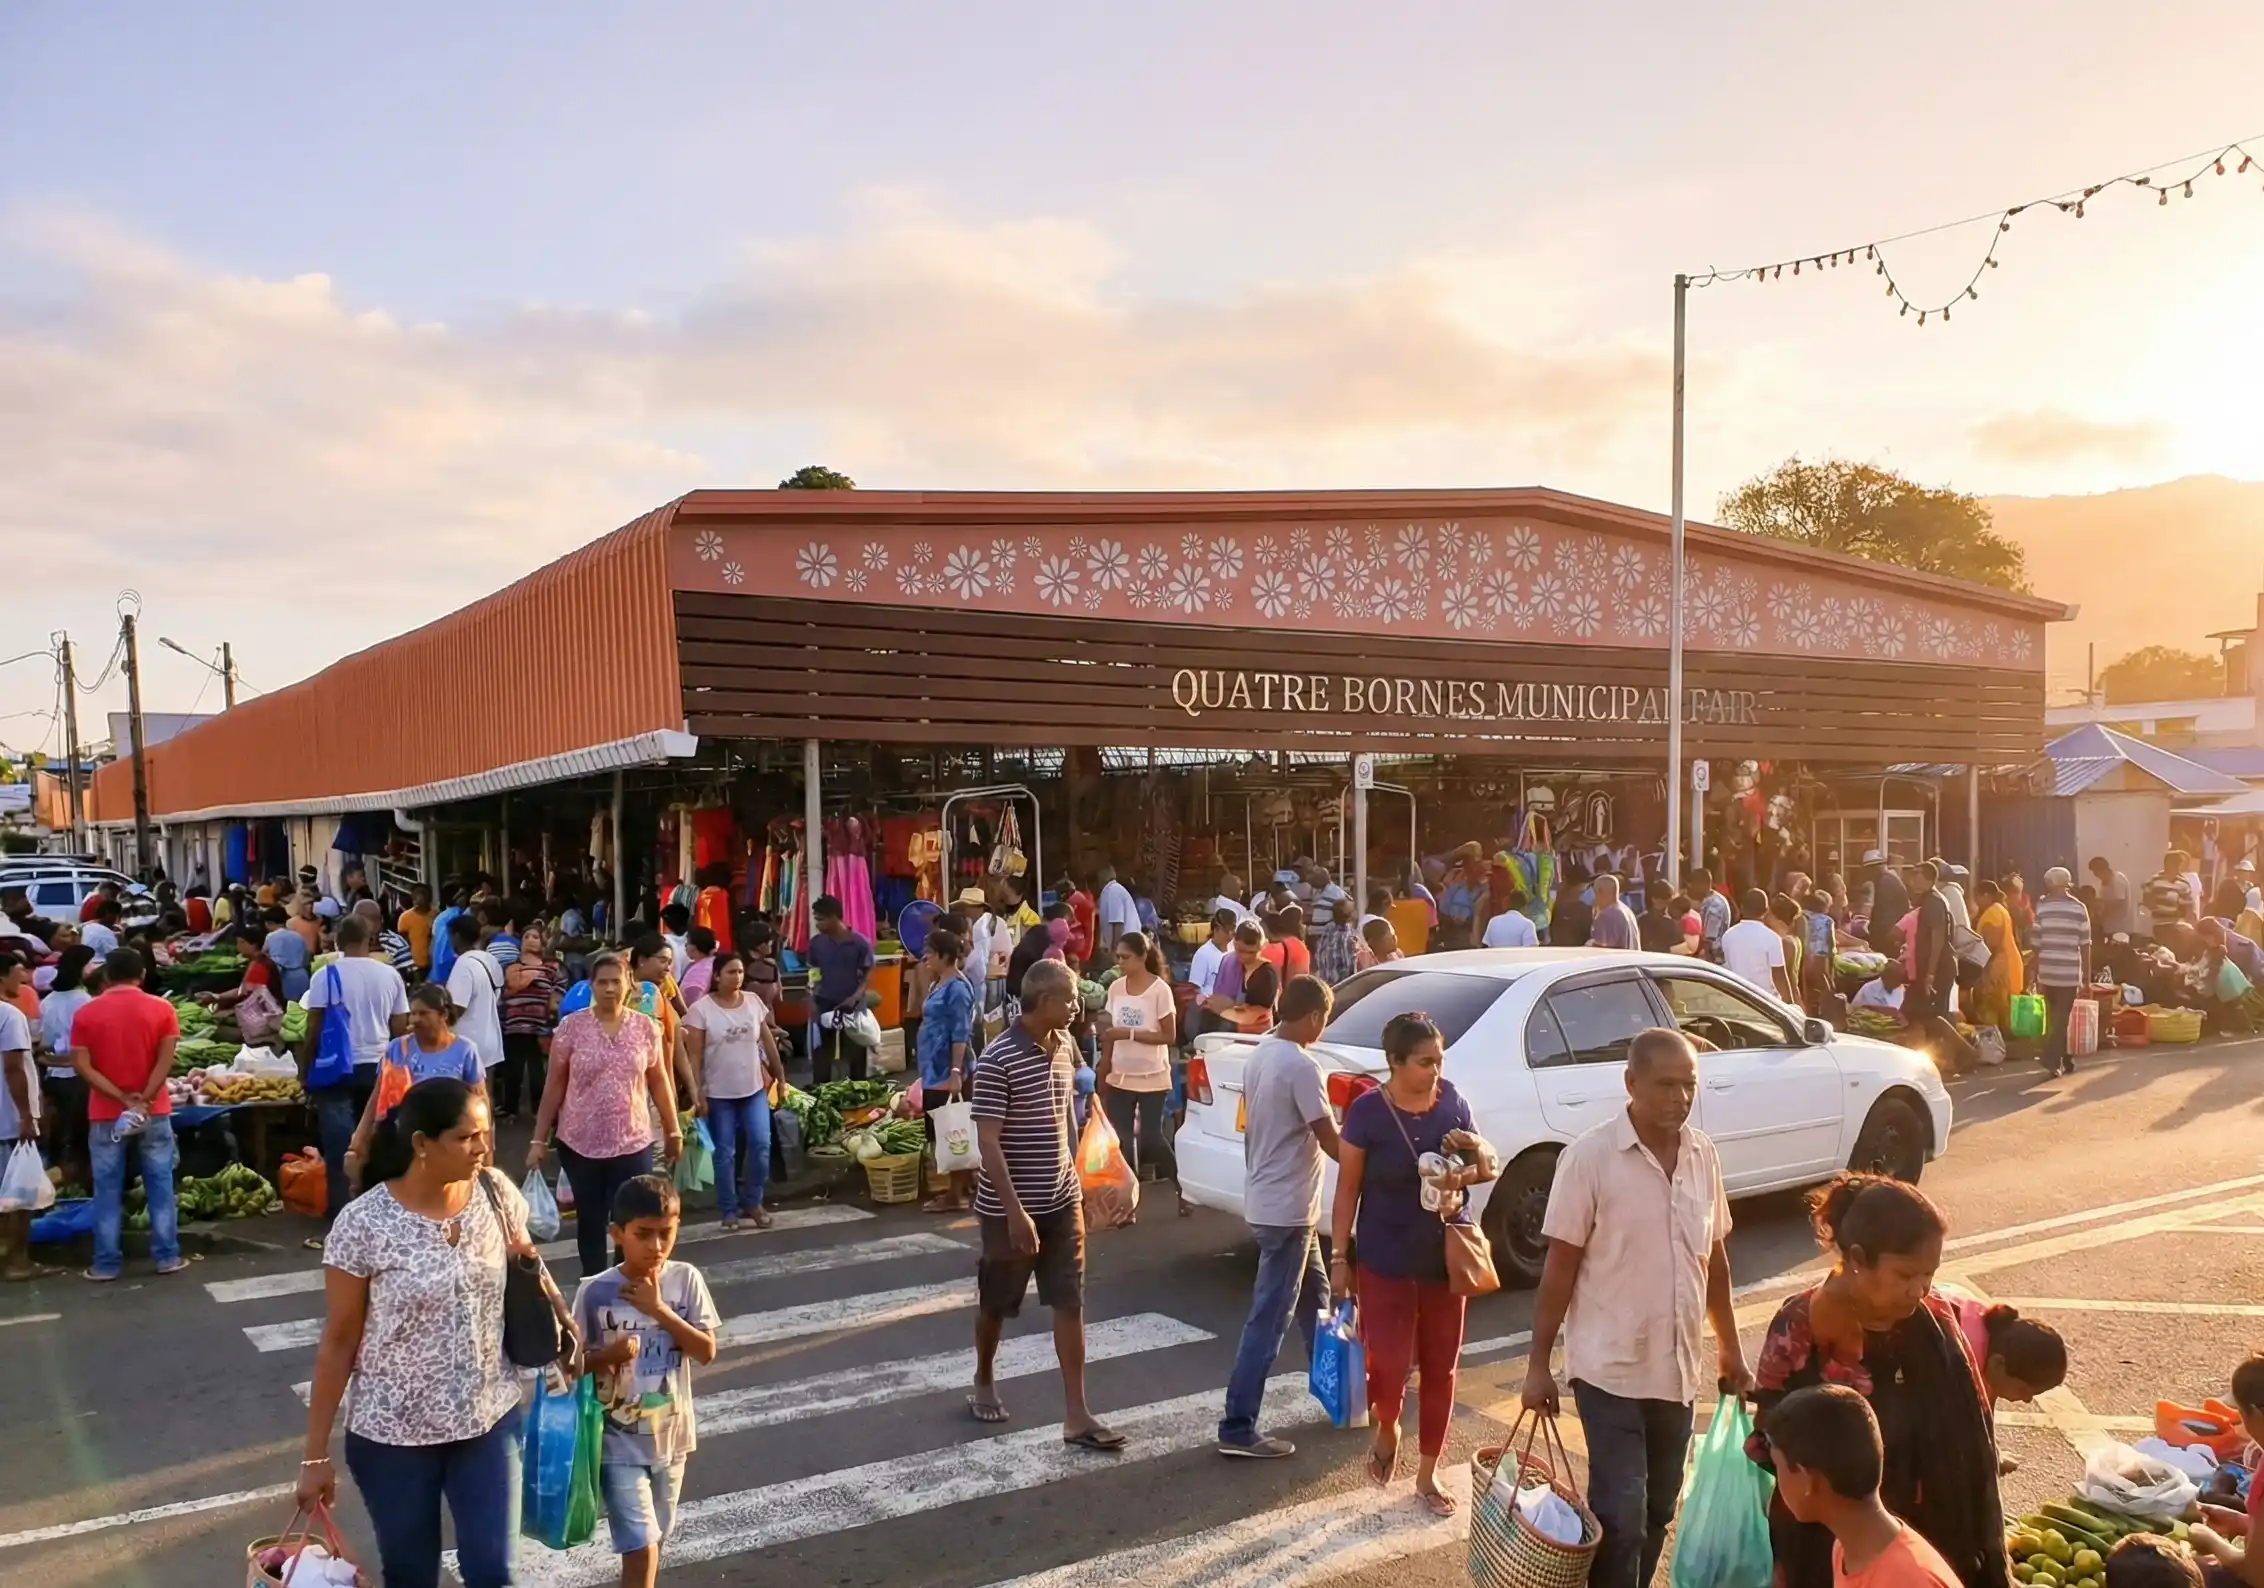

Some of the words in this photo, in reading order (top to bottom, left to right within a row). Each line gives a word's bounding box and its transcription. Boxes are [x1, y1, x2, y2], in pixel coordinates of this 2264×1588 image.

[1172, 669, 1330, 717] QUATRE
[1343, 677, 1486, 716] BORNES
[1690, 689, 1758, 724] FAIR
